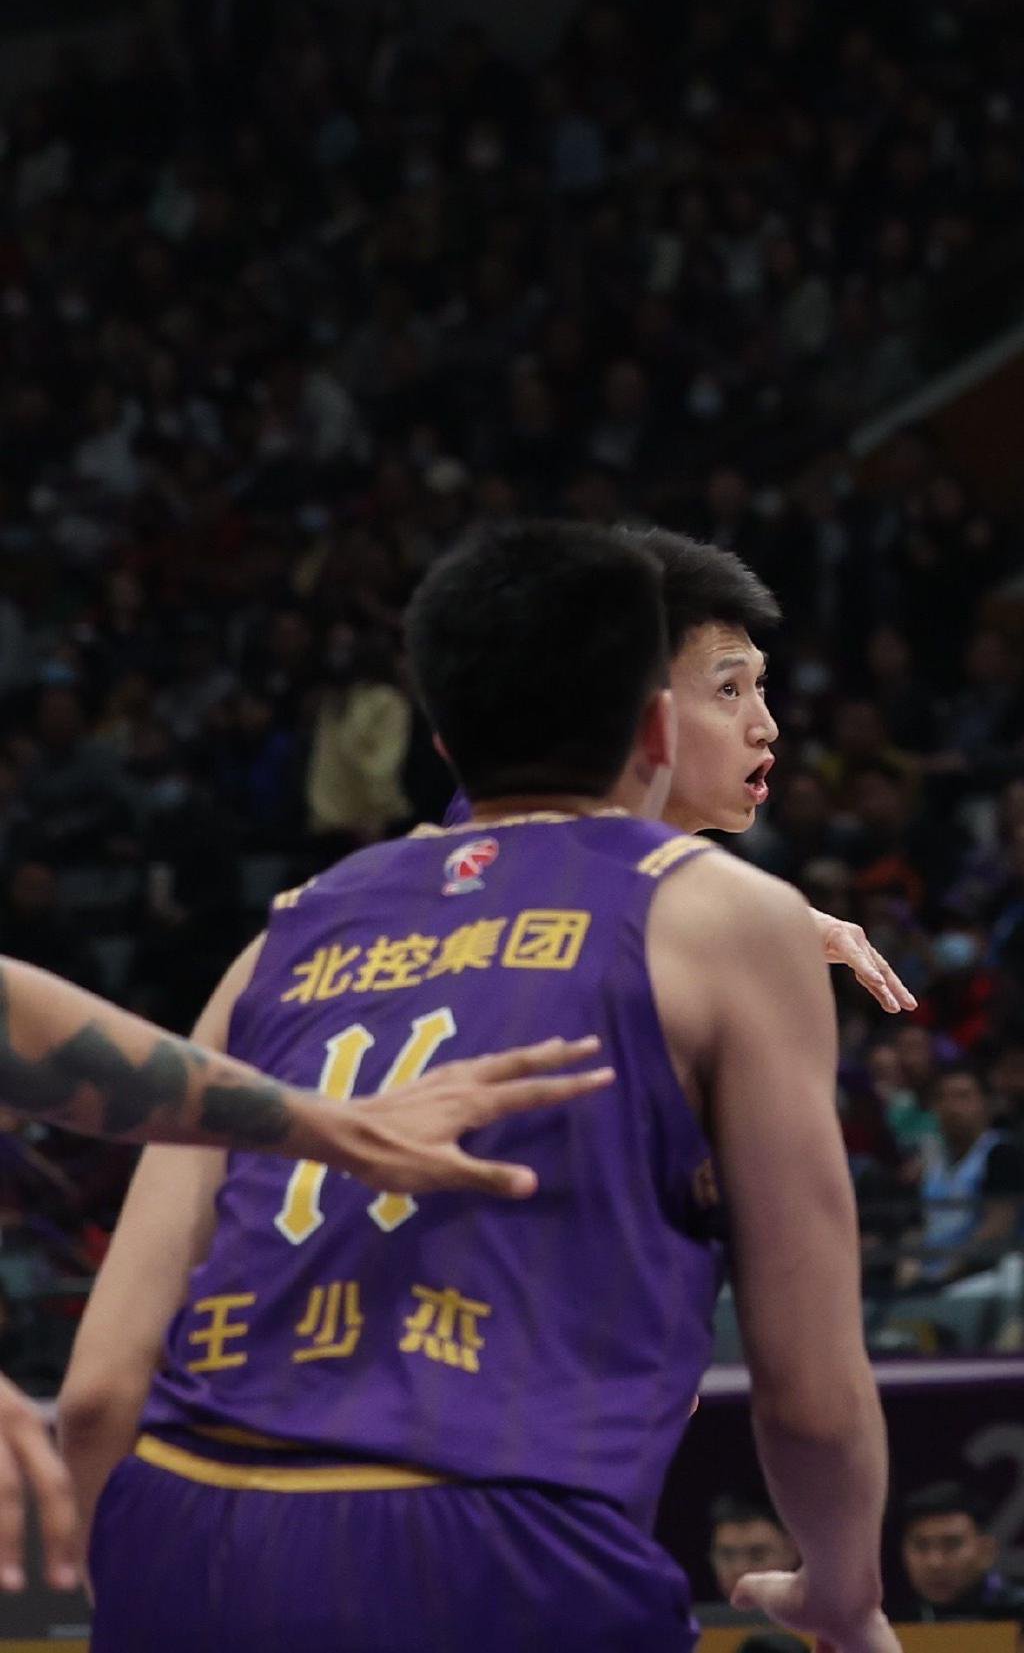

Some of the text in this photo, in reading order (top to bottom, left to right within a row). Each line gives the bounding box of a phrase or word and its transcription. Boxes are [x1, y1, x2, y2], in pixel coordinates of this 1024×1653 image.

[280, 909, 591, 1005] 北控集团
[188, 1280, 491, 1374] 王少杰
